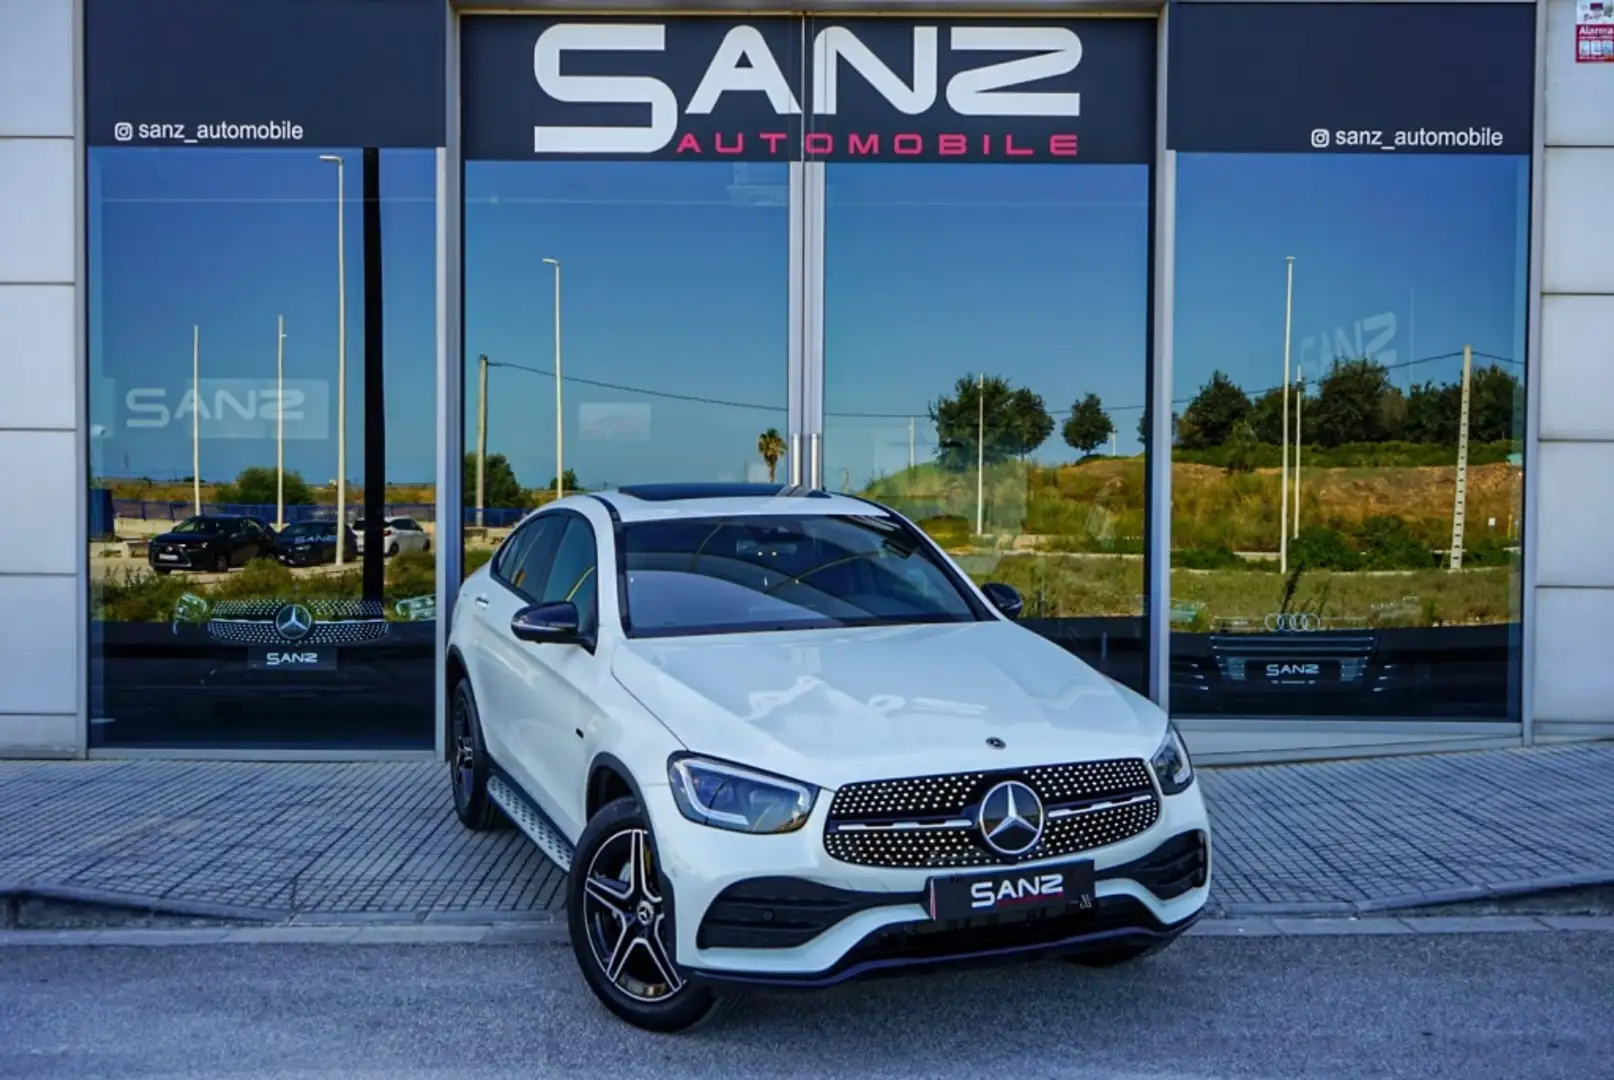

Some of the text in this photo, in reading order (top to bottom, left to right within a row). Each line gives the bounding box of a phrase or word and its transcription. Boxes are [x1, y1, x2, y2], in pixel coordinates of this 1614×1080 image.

[534, 23, 1083, 153] SANZ
[138, 121, 304, 143] sanz_automobile
[1335, 127, 1504, 150] sanz_automobile
[676, 133, 1078, 156] AUTOMOBILE
[125, 387, 306, 428] SANZ
[266, 652, 318, 665] SANZ
[1266, 664, 1319, 676] SANZ
[971, 873, 1064, 908] SANZ
